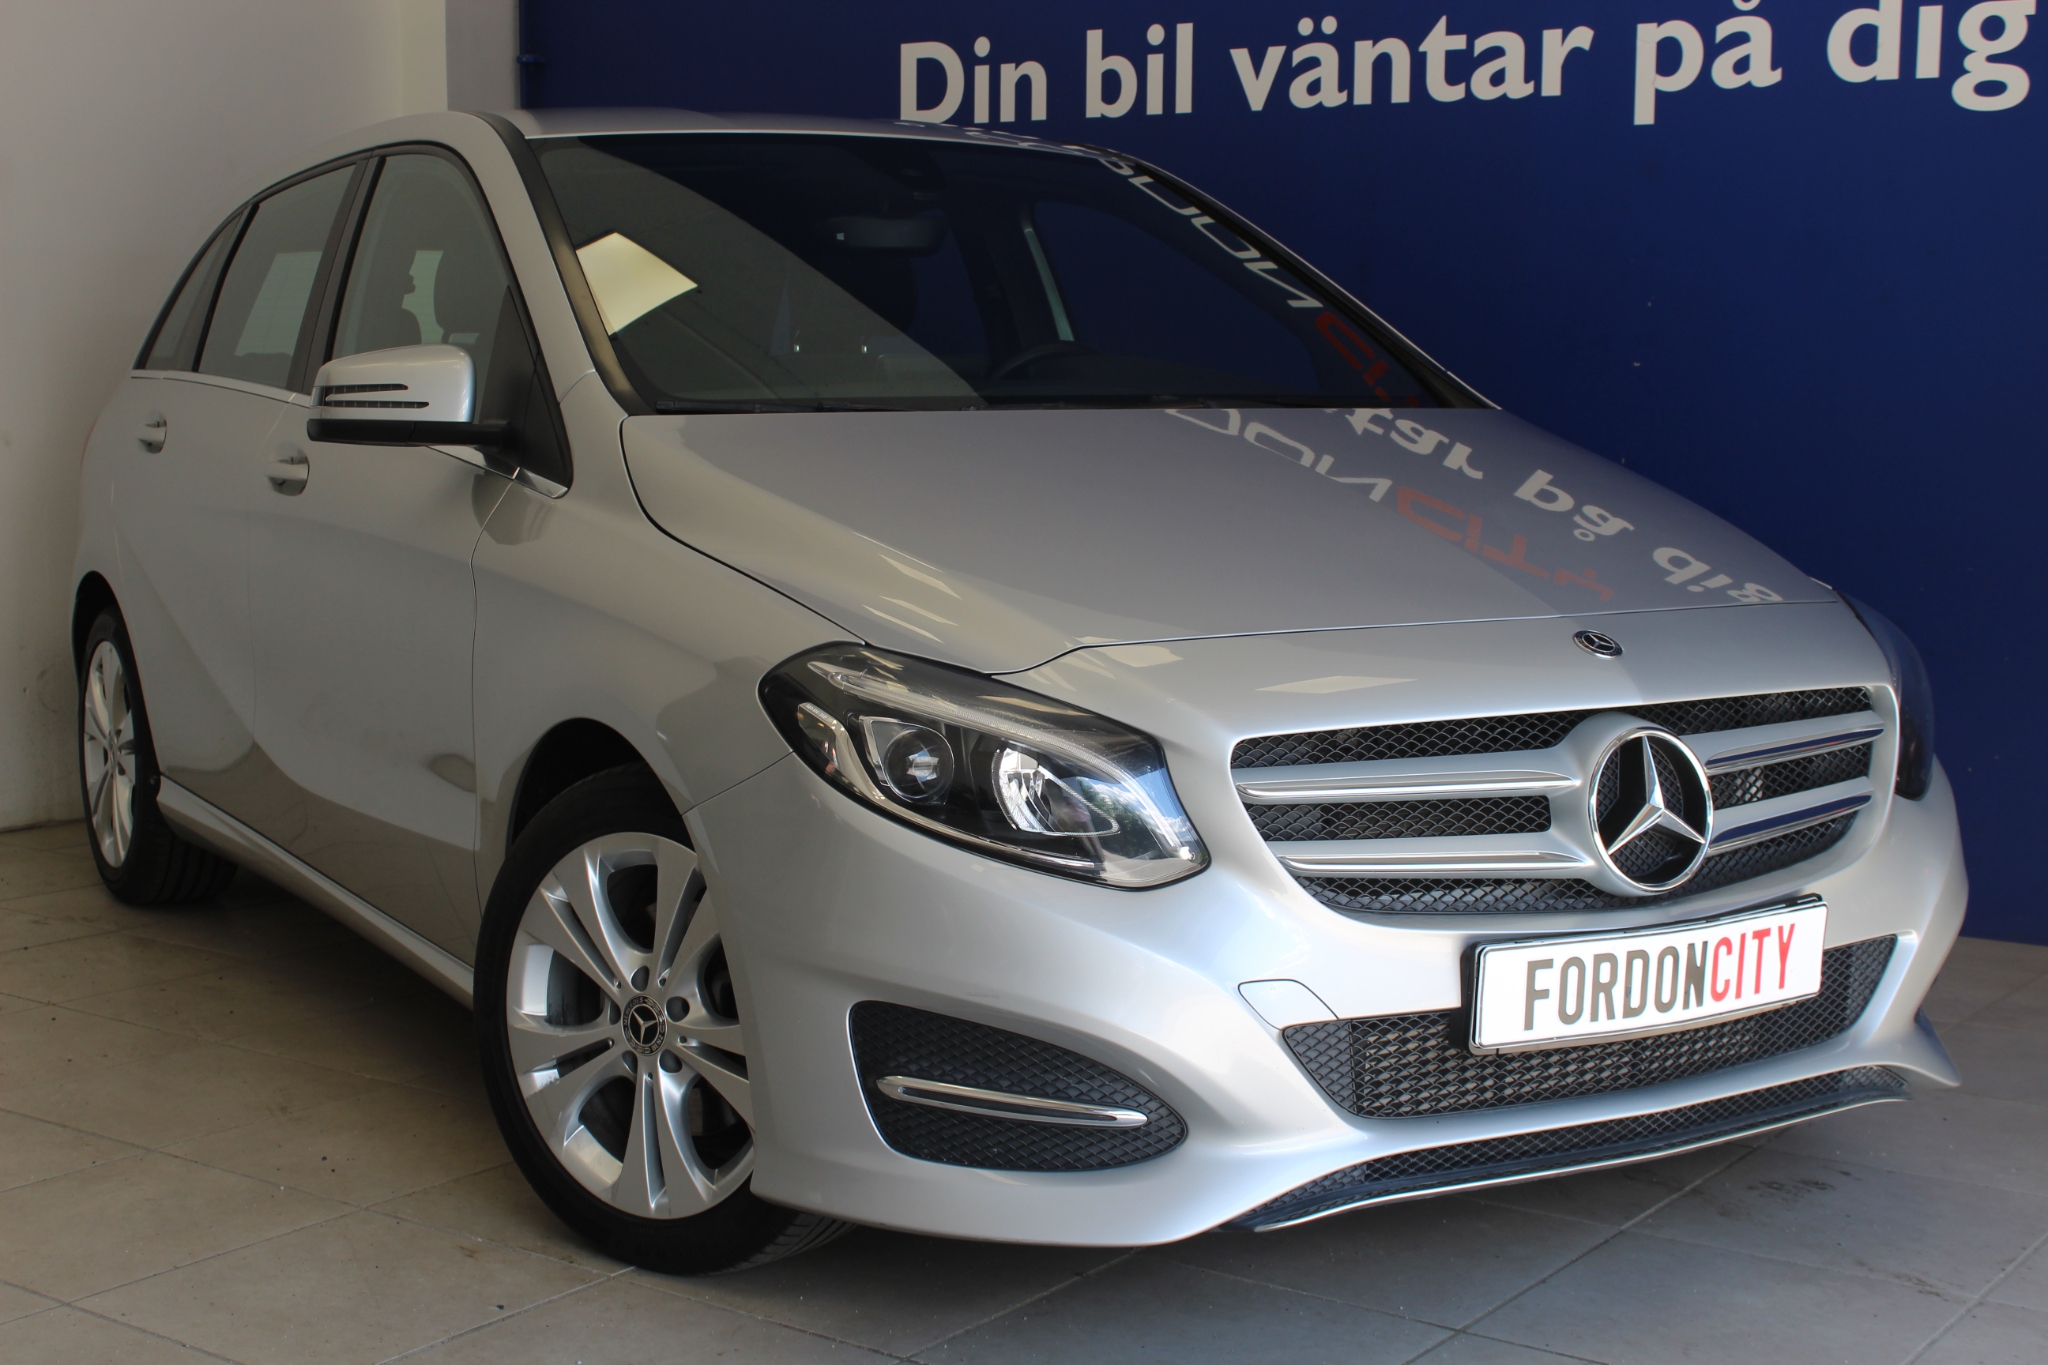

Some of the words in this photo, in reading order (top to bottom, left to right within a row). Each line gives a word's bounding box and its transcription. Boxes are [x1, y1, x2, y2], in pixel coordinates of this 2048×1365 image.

[901, 36, 1047, 124] Din
[1085, 22, 1194, 118] bil
[1229, 15, 1595, 111] väntar
[1633, 0, 1783, 126] på
[1827, 0, 2037, 112] dig
[1523, 922, 1796, 1032] FORDONCITY
